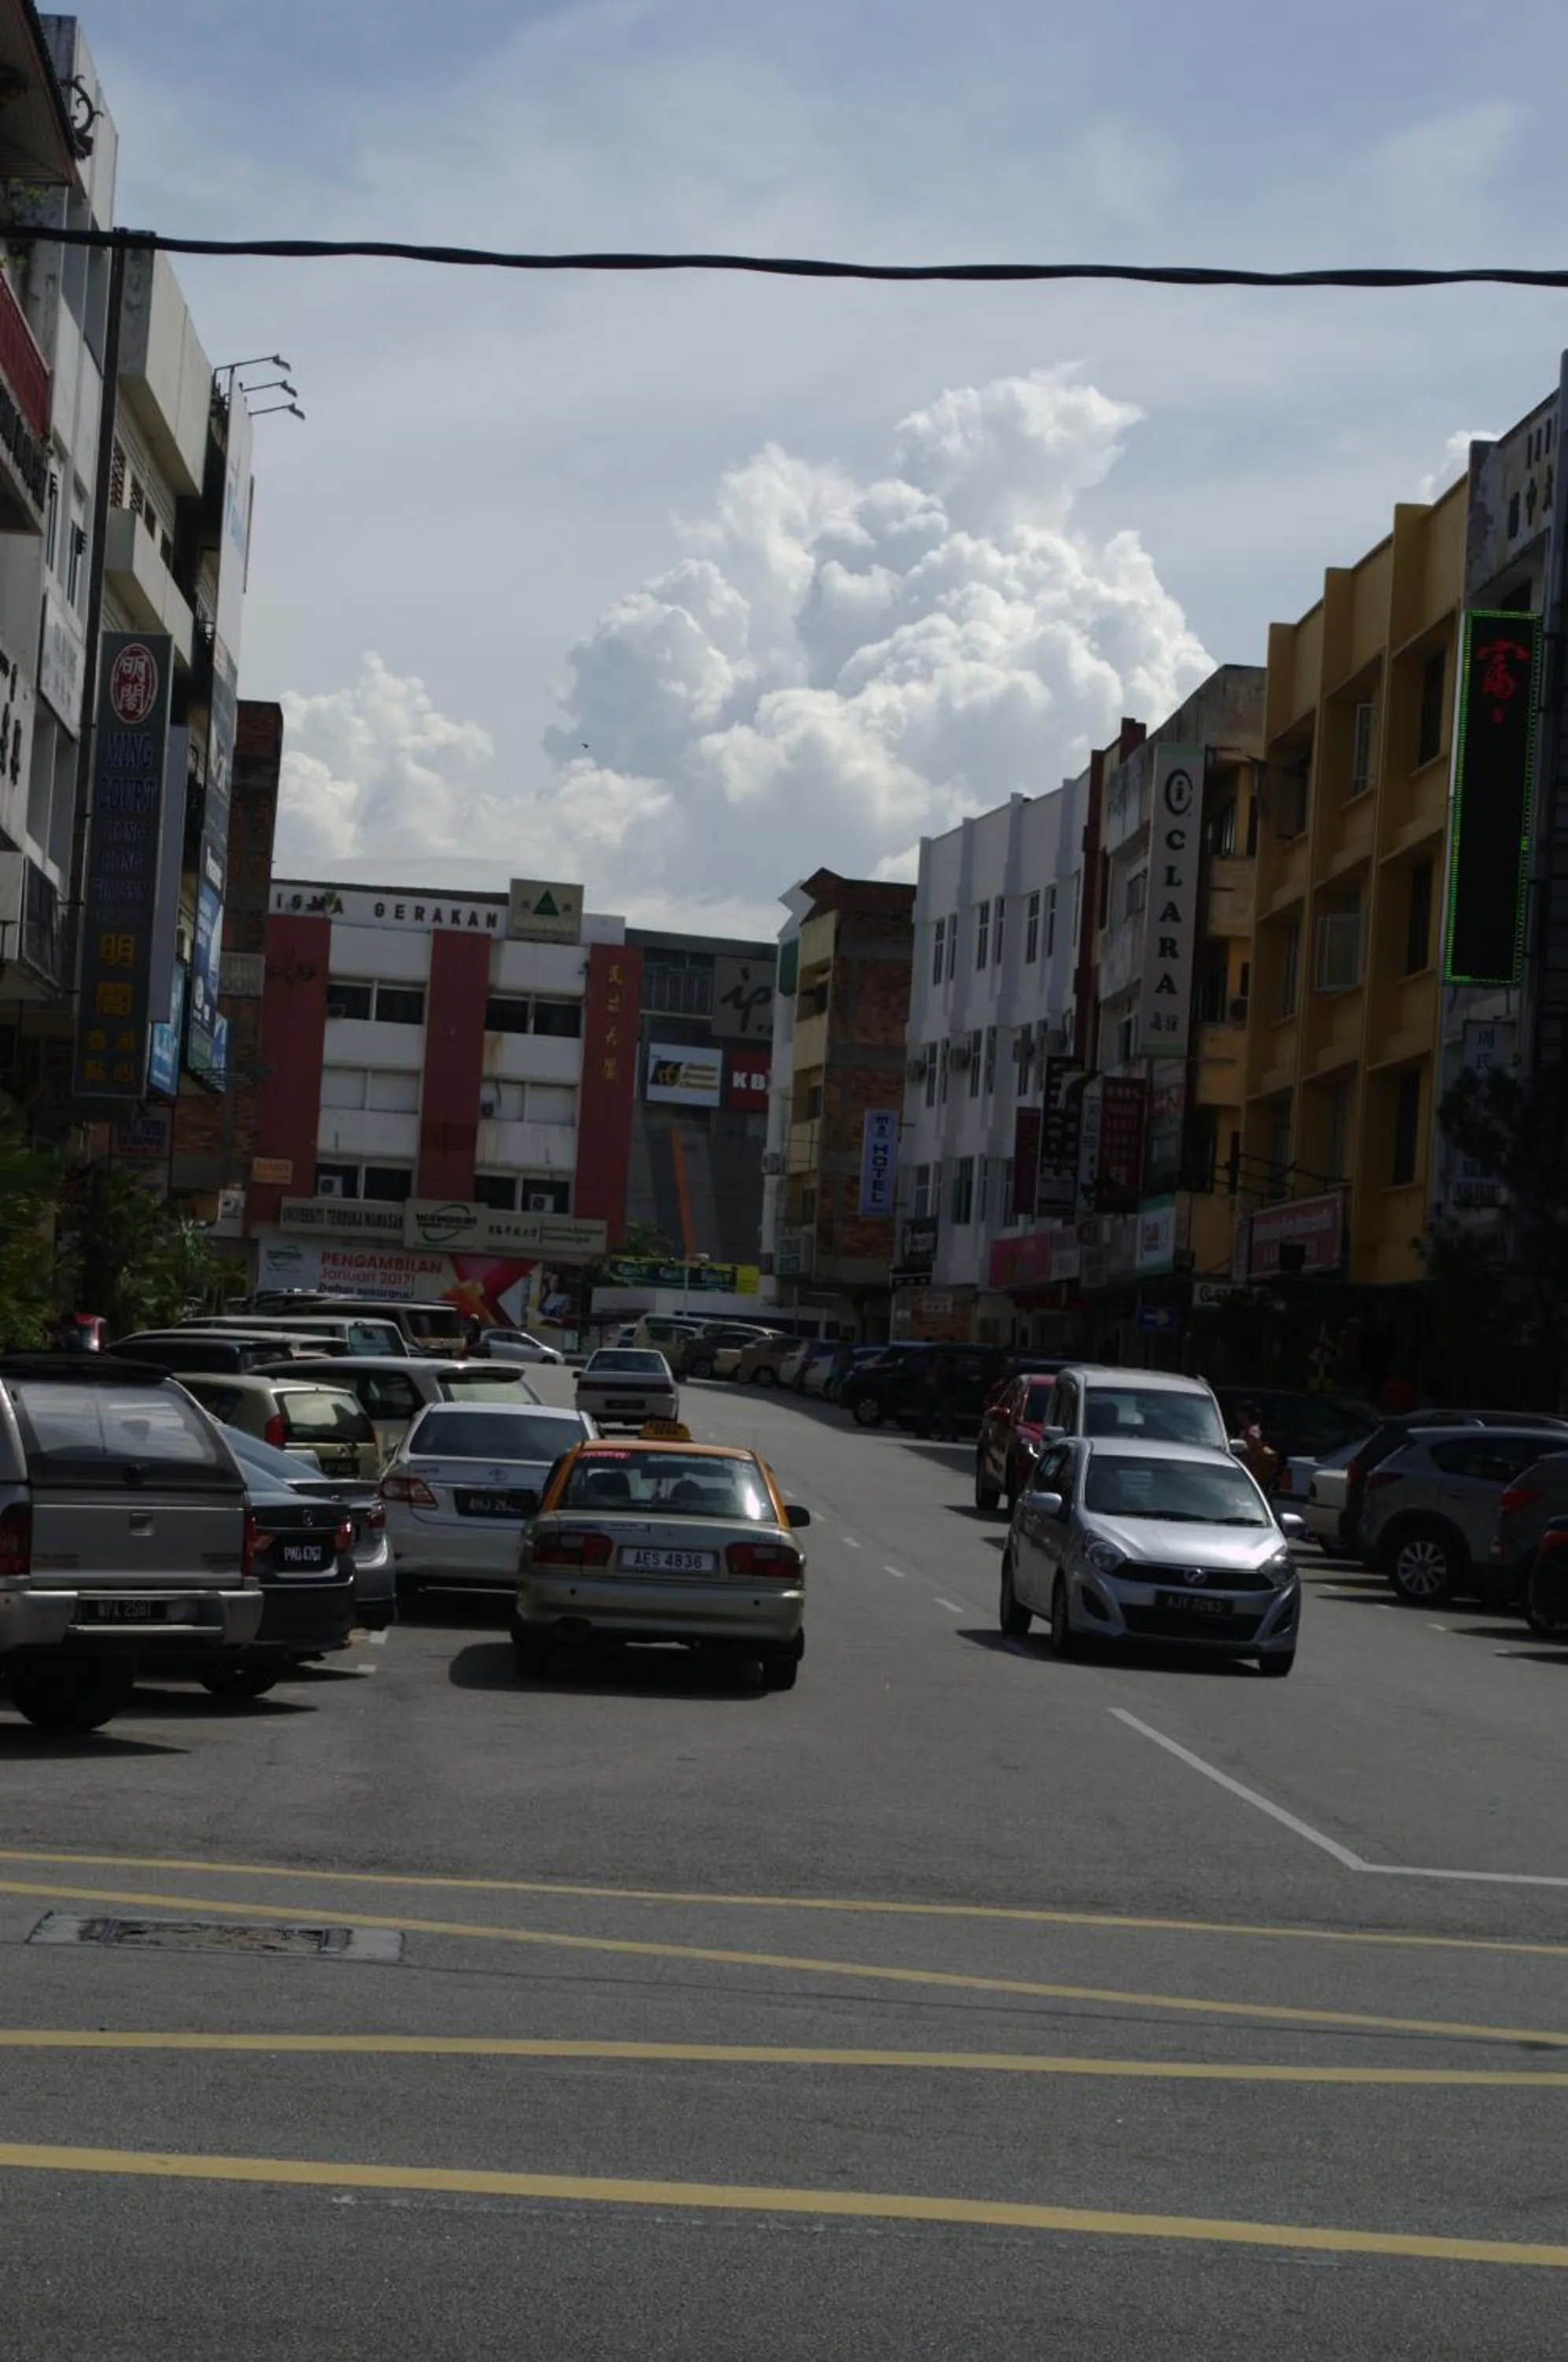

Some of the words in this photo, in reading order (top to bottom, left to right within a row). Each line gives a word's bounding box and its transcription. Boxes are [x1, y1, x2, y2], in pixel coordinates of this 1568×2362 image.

[374, 902, 497, 929] GERAKAN
[871, 1144, 889, 1203] HOTEL
[321, 1251, 442, 1273] PENGAMBILAN
[634, 1549, 661, 1566] AES
